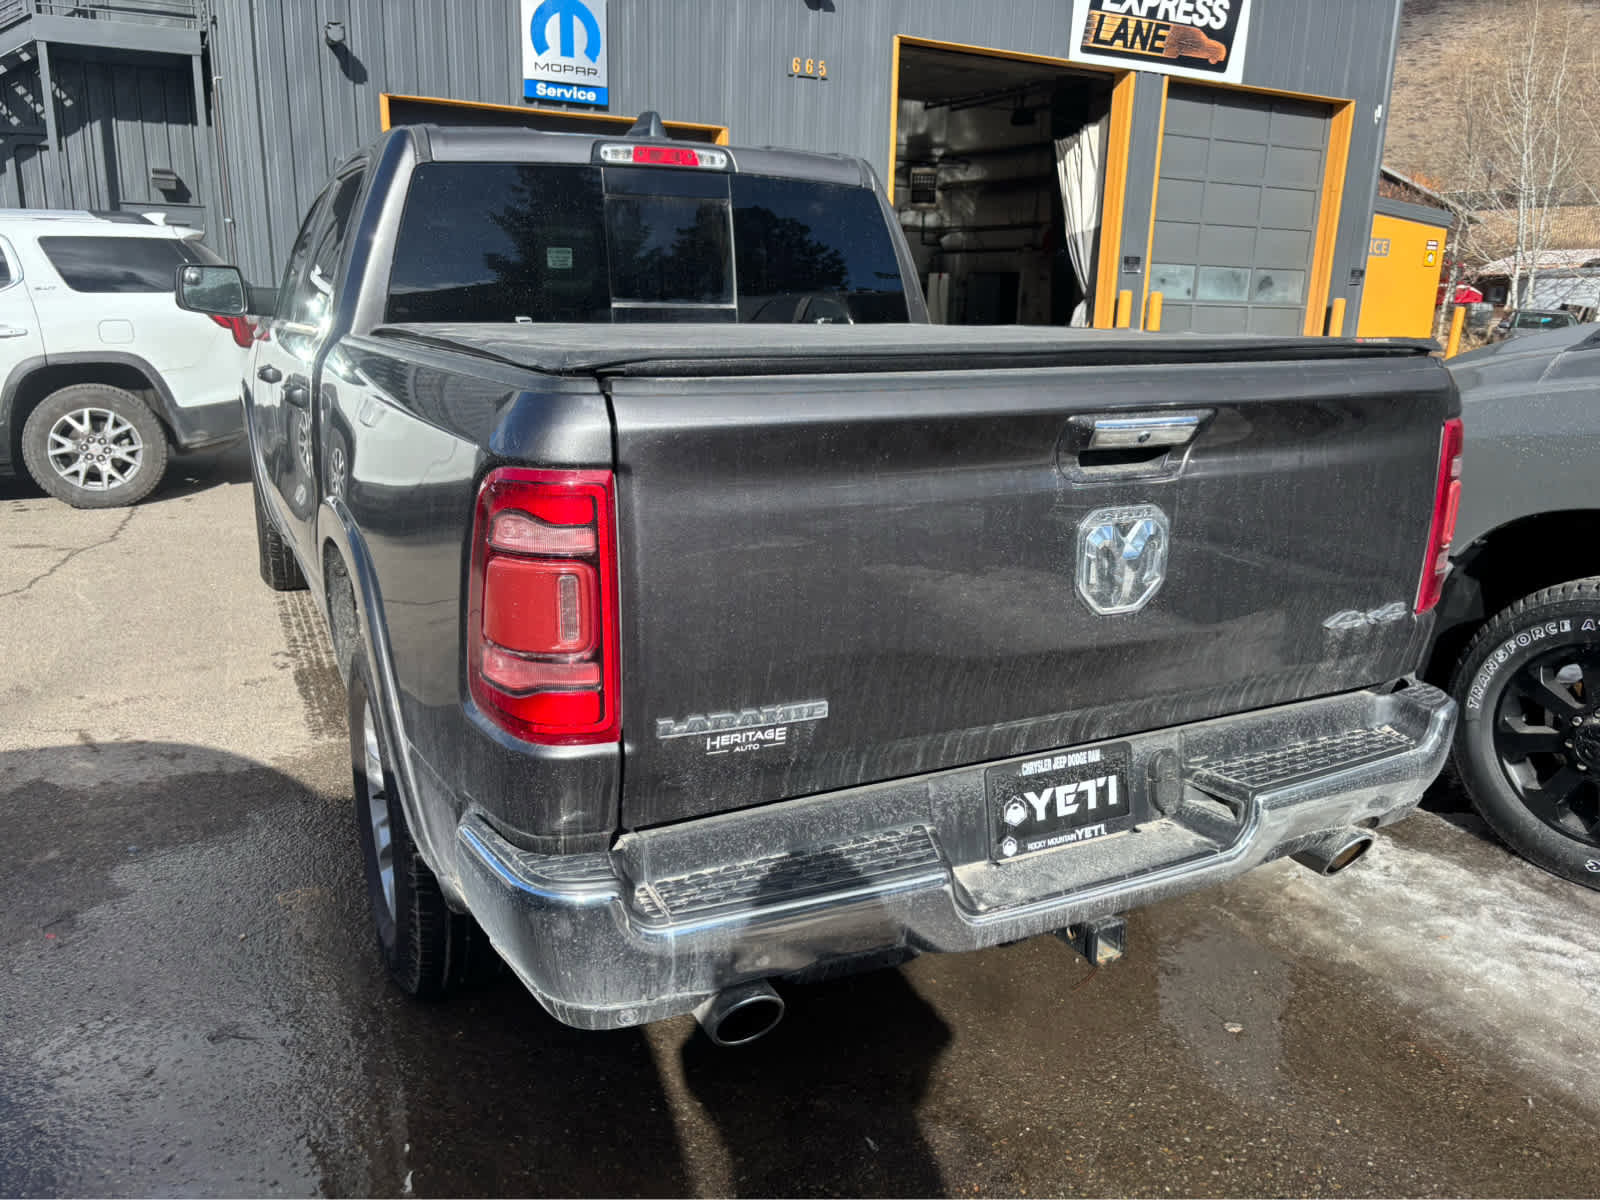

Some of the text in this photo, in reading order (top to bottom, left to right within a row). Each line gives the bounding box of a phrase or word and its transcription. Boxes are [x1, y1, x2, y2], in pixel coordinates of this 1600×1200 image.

[1092, 14, 1171, 54] LANE
[534, 62, 599, 77] MOPAR
[792, 57, 827, 77] 665
[536, 82, 597, 102] Service
[1467, 618, 1600, 711] TRANSFORCE A
[707, 728, 786, 750] HERITAGE
[733, 743, 760, 753] AUTO
[1053, 755, 1067, 770] JEEP
[1067, 751, 1087, 767] DODGE
[1024, 775, 1117, 821] YETI
[1027, 839, 1046, 851] ROCKY
